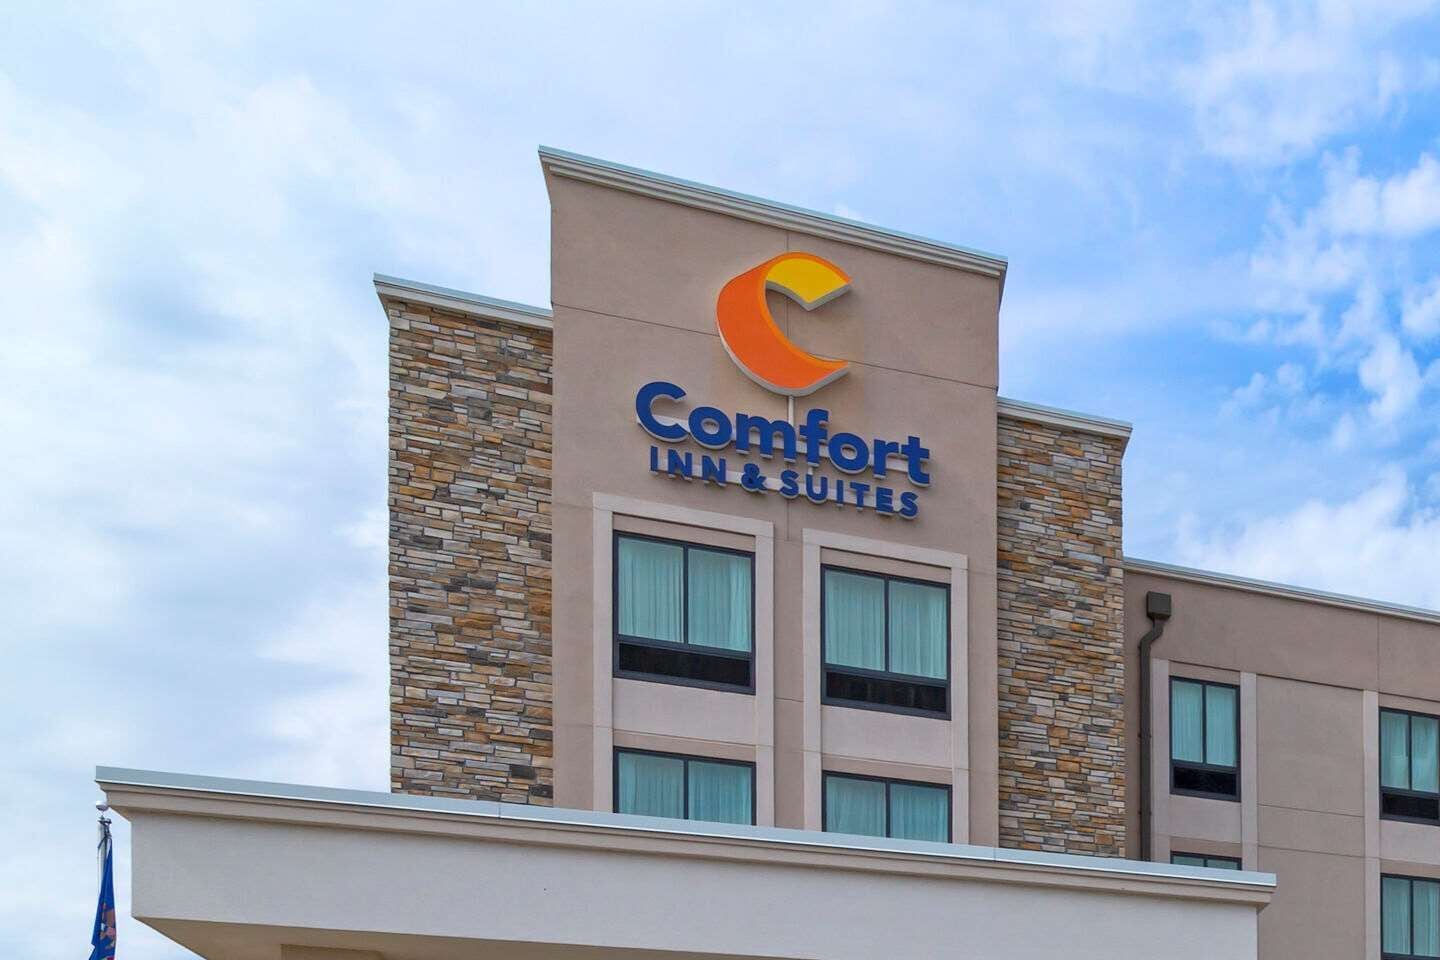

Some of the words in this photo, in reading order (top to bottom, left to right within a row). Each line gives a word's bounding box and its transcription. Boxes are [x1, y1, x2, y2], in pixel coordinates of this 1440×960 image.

[635, 381, 930, 487] Comfort
[650, 446, 727, 486] INN
[740, 463, 767, 492] &
[779, 470, 919, 519] SUITES
